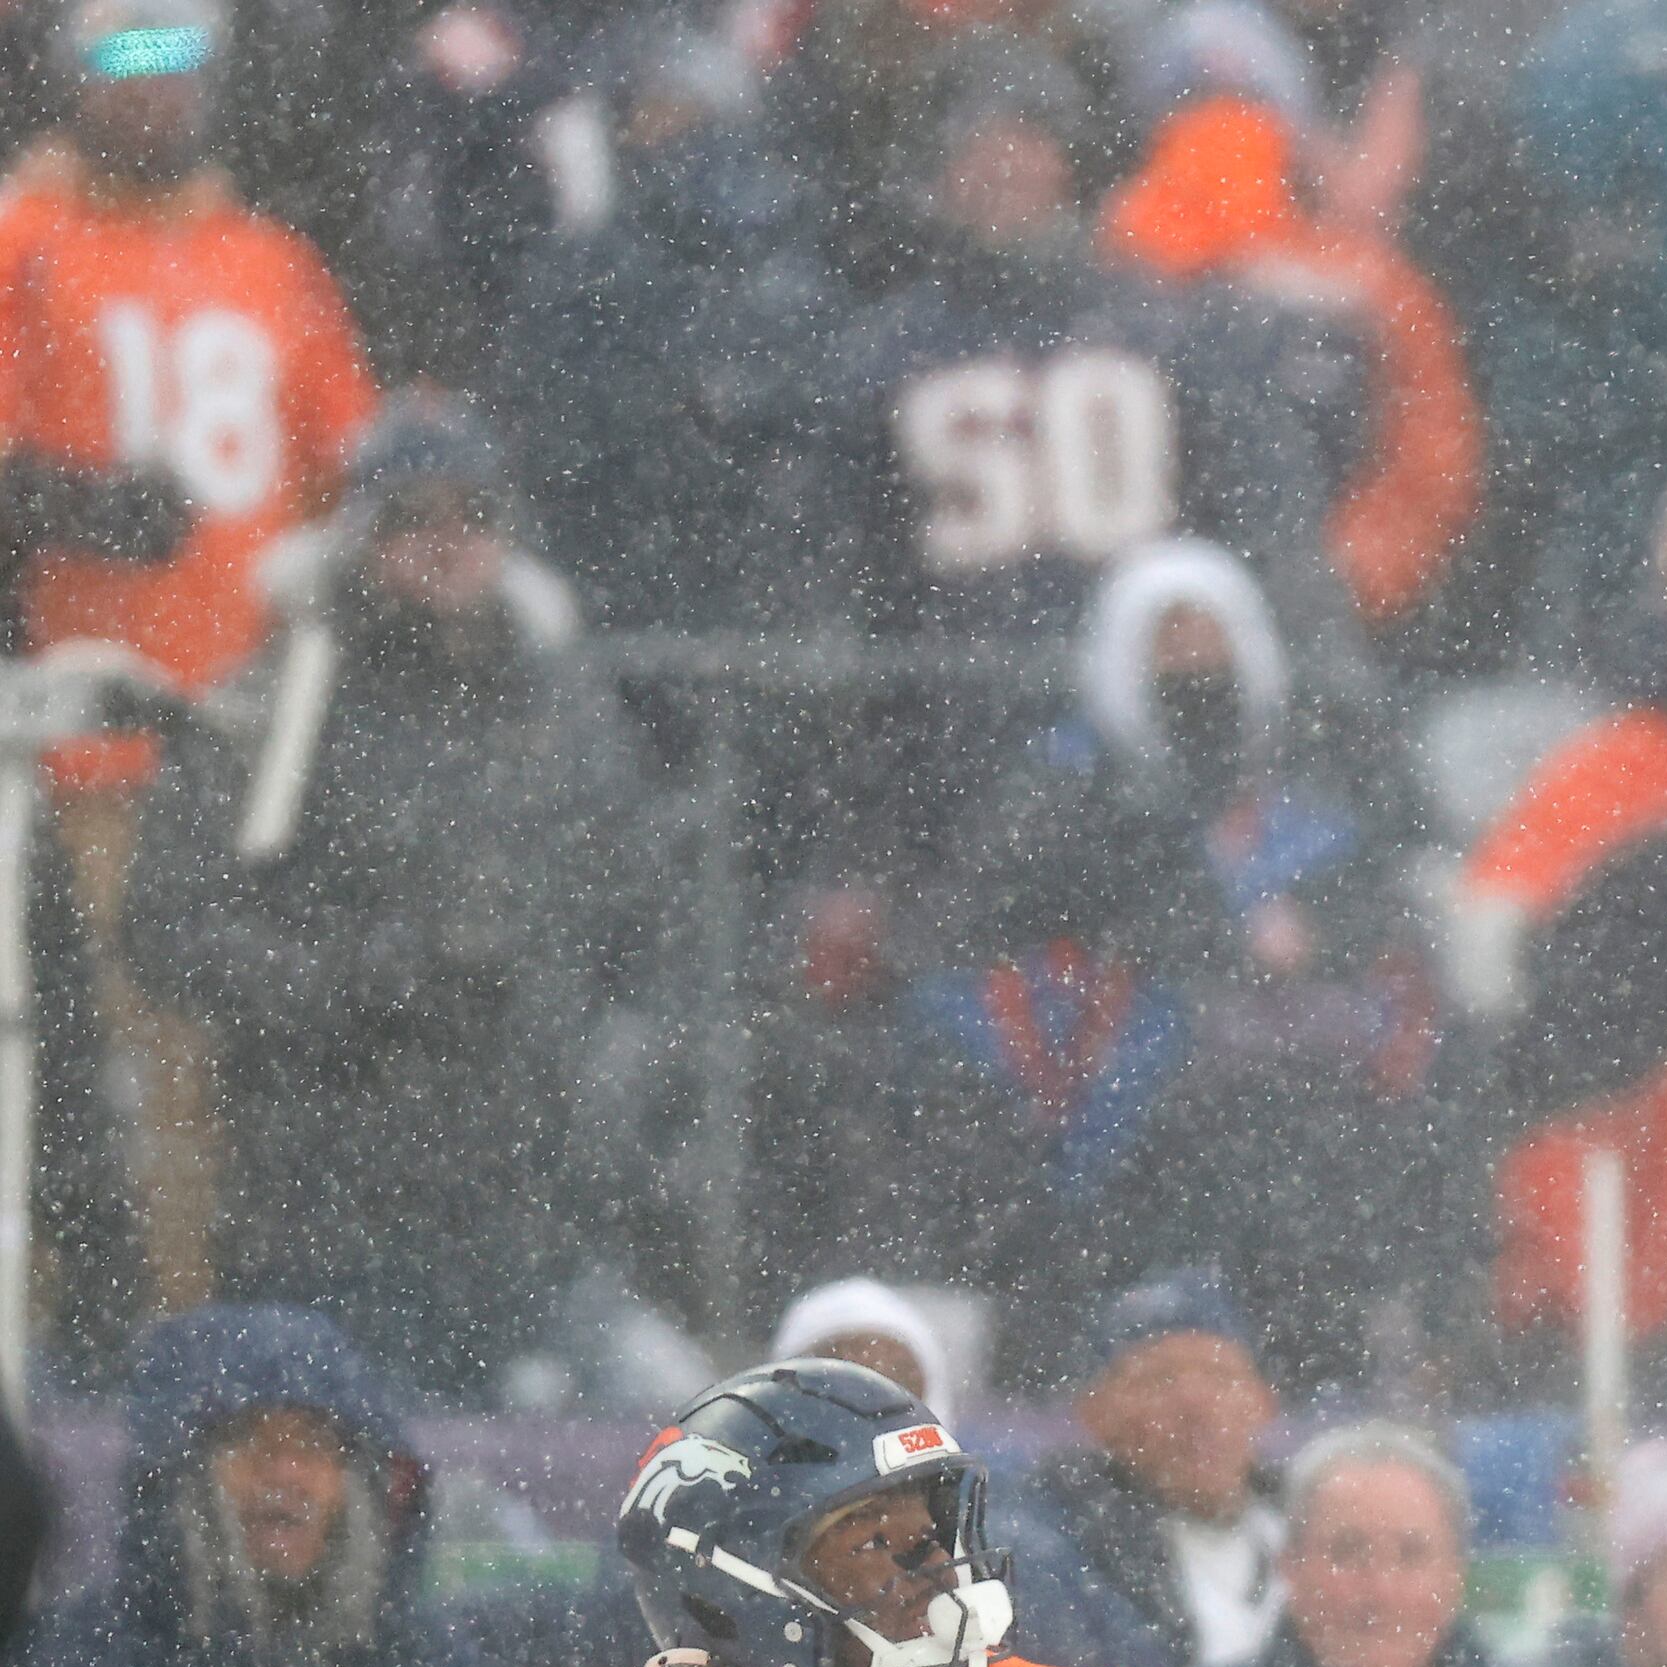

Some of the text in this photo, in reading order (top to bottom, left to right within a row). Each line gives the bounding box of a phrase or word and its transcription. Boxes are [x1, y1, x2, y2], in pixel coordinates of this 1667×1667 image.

[101, 301, 284, 515] 18
[900, 353, 1172, 565] 50
[898, 1426, 944, 1453] 52
